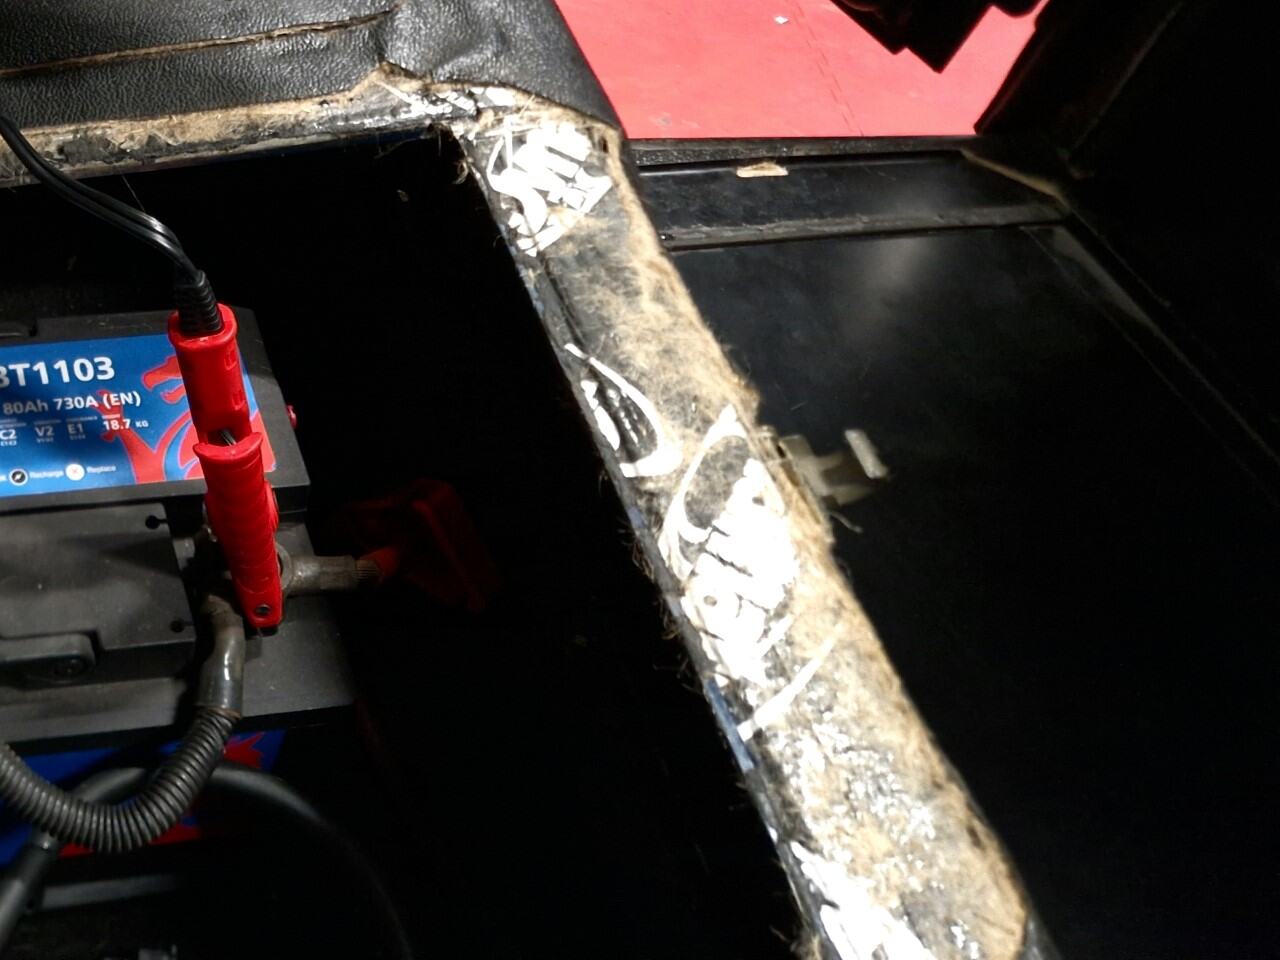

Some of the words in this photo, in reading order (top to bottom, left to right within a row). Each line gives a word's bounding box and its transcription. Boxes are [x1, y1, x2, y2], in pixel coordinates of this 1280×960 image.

[2, 399, 49, 415] 80Ah
[53, 396, 99, 411] 730A
[102, 391, 142, 410] (EN)
[34, 426, 55, 438] V2
[67, 423, 84, 435] E1
[102, 418, 131, 431] 18.7
[136, 420, 149, 429] KG
